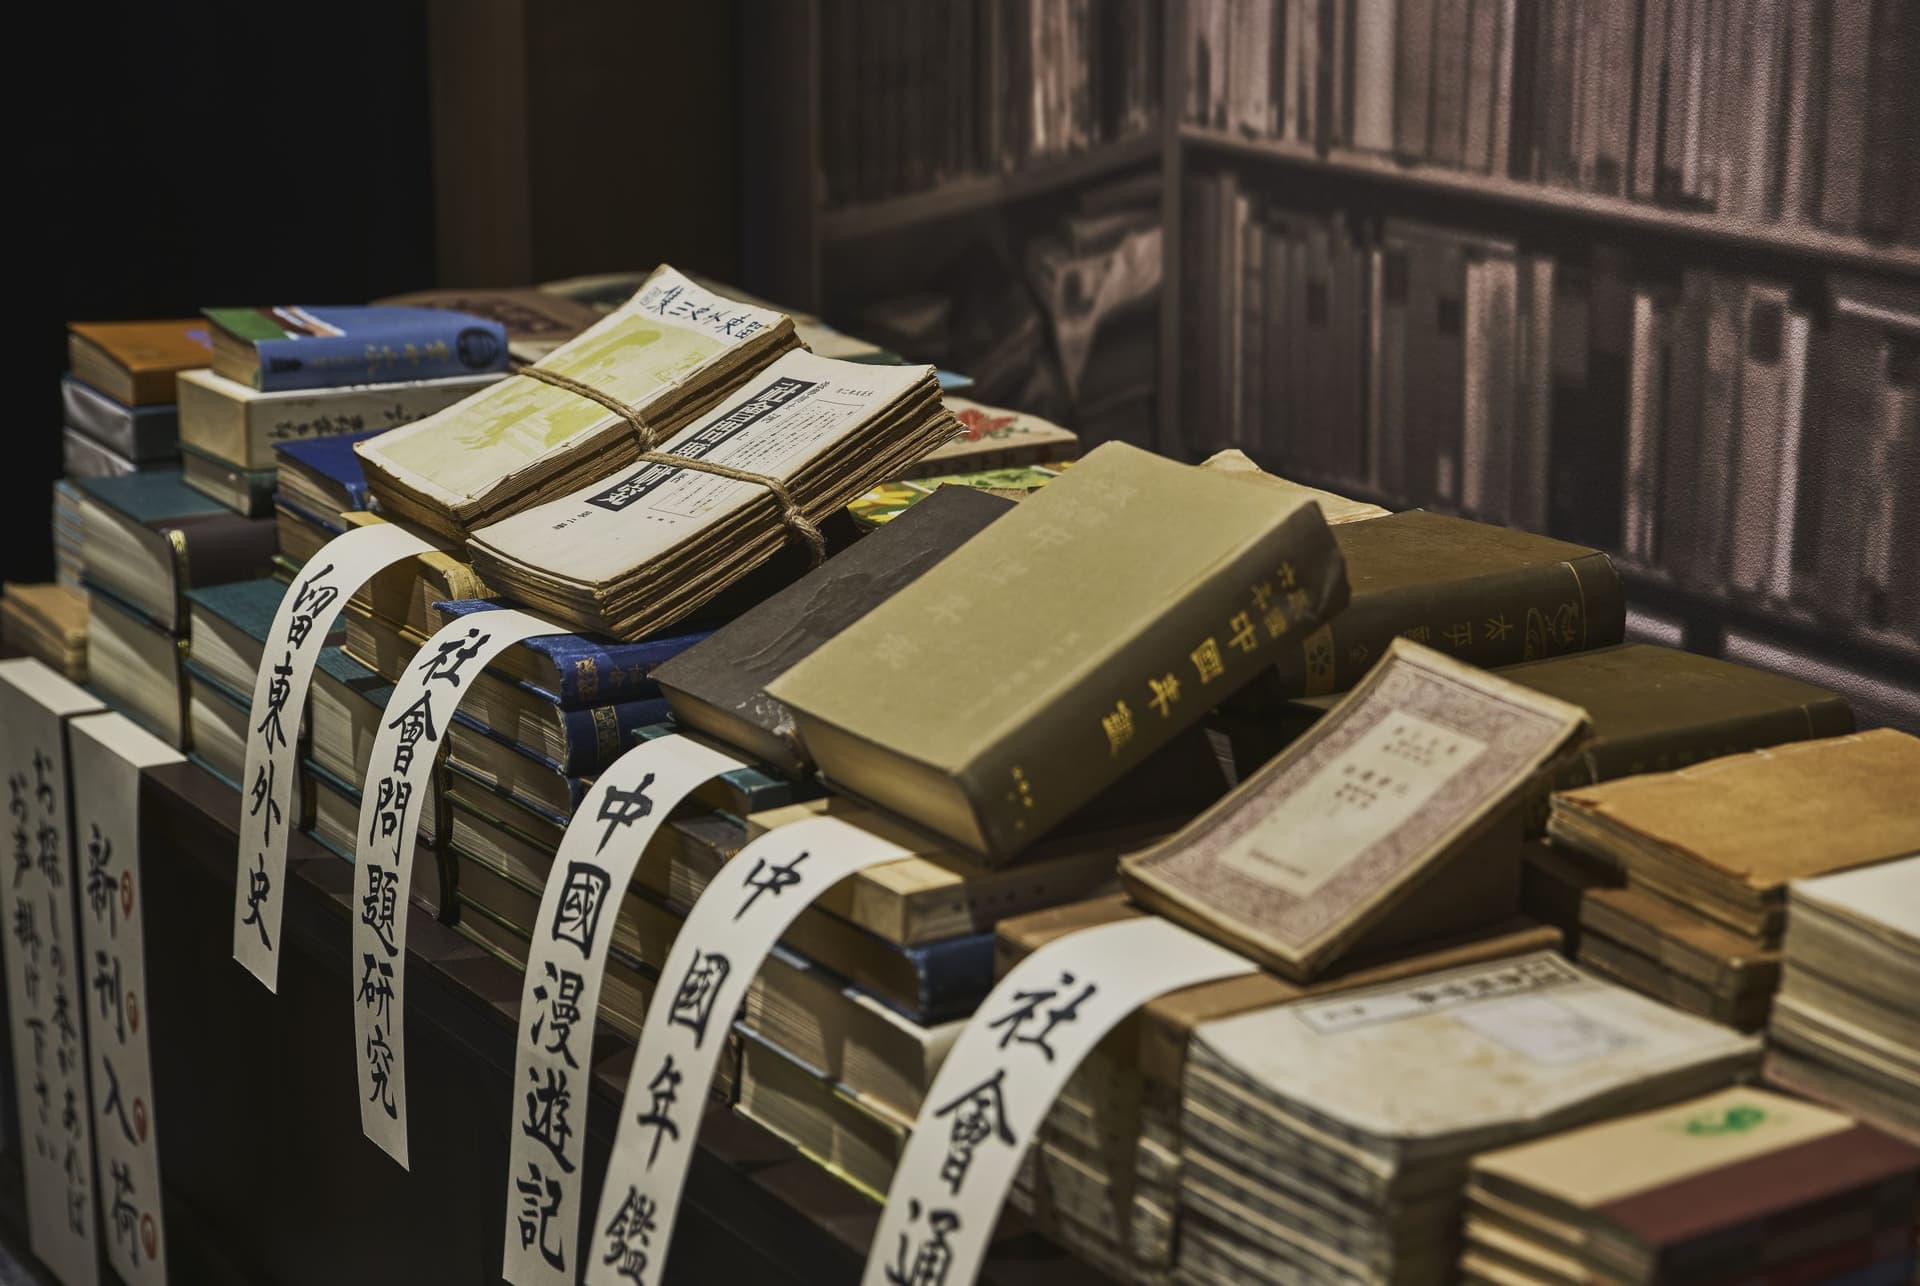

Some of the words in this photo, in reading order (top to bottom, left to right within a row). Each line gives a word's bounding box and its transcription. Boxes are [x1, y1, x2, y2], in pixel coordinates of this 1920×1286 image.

[242, 563, 338, 952] 留東外史
[359, 627, 497, 1120] 社會問題研究
[87, 823, 139, 1268] 新刊入荷
[516, 773, 655, 1272] 中國漫遊記
[603, 851, 811, 1286] 中國年鑑
